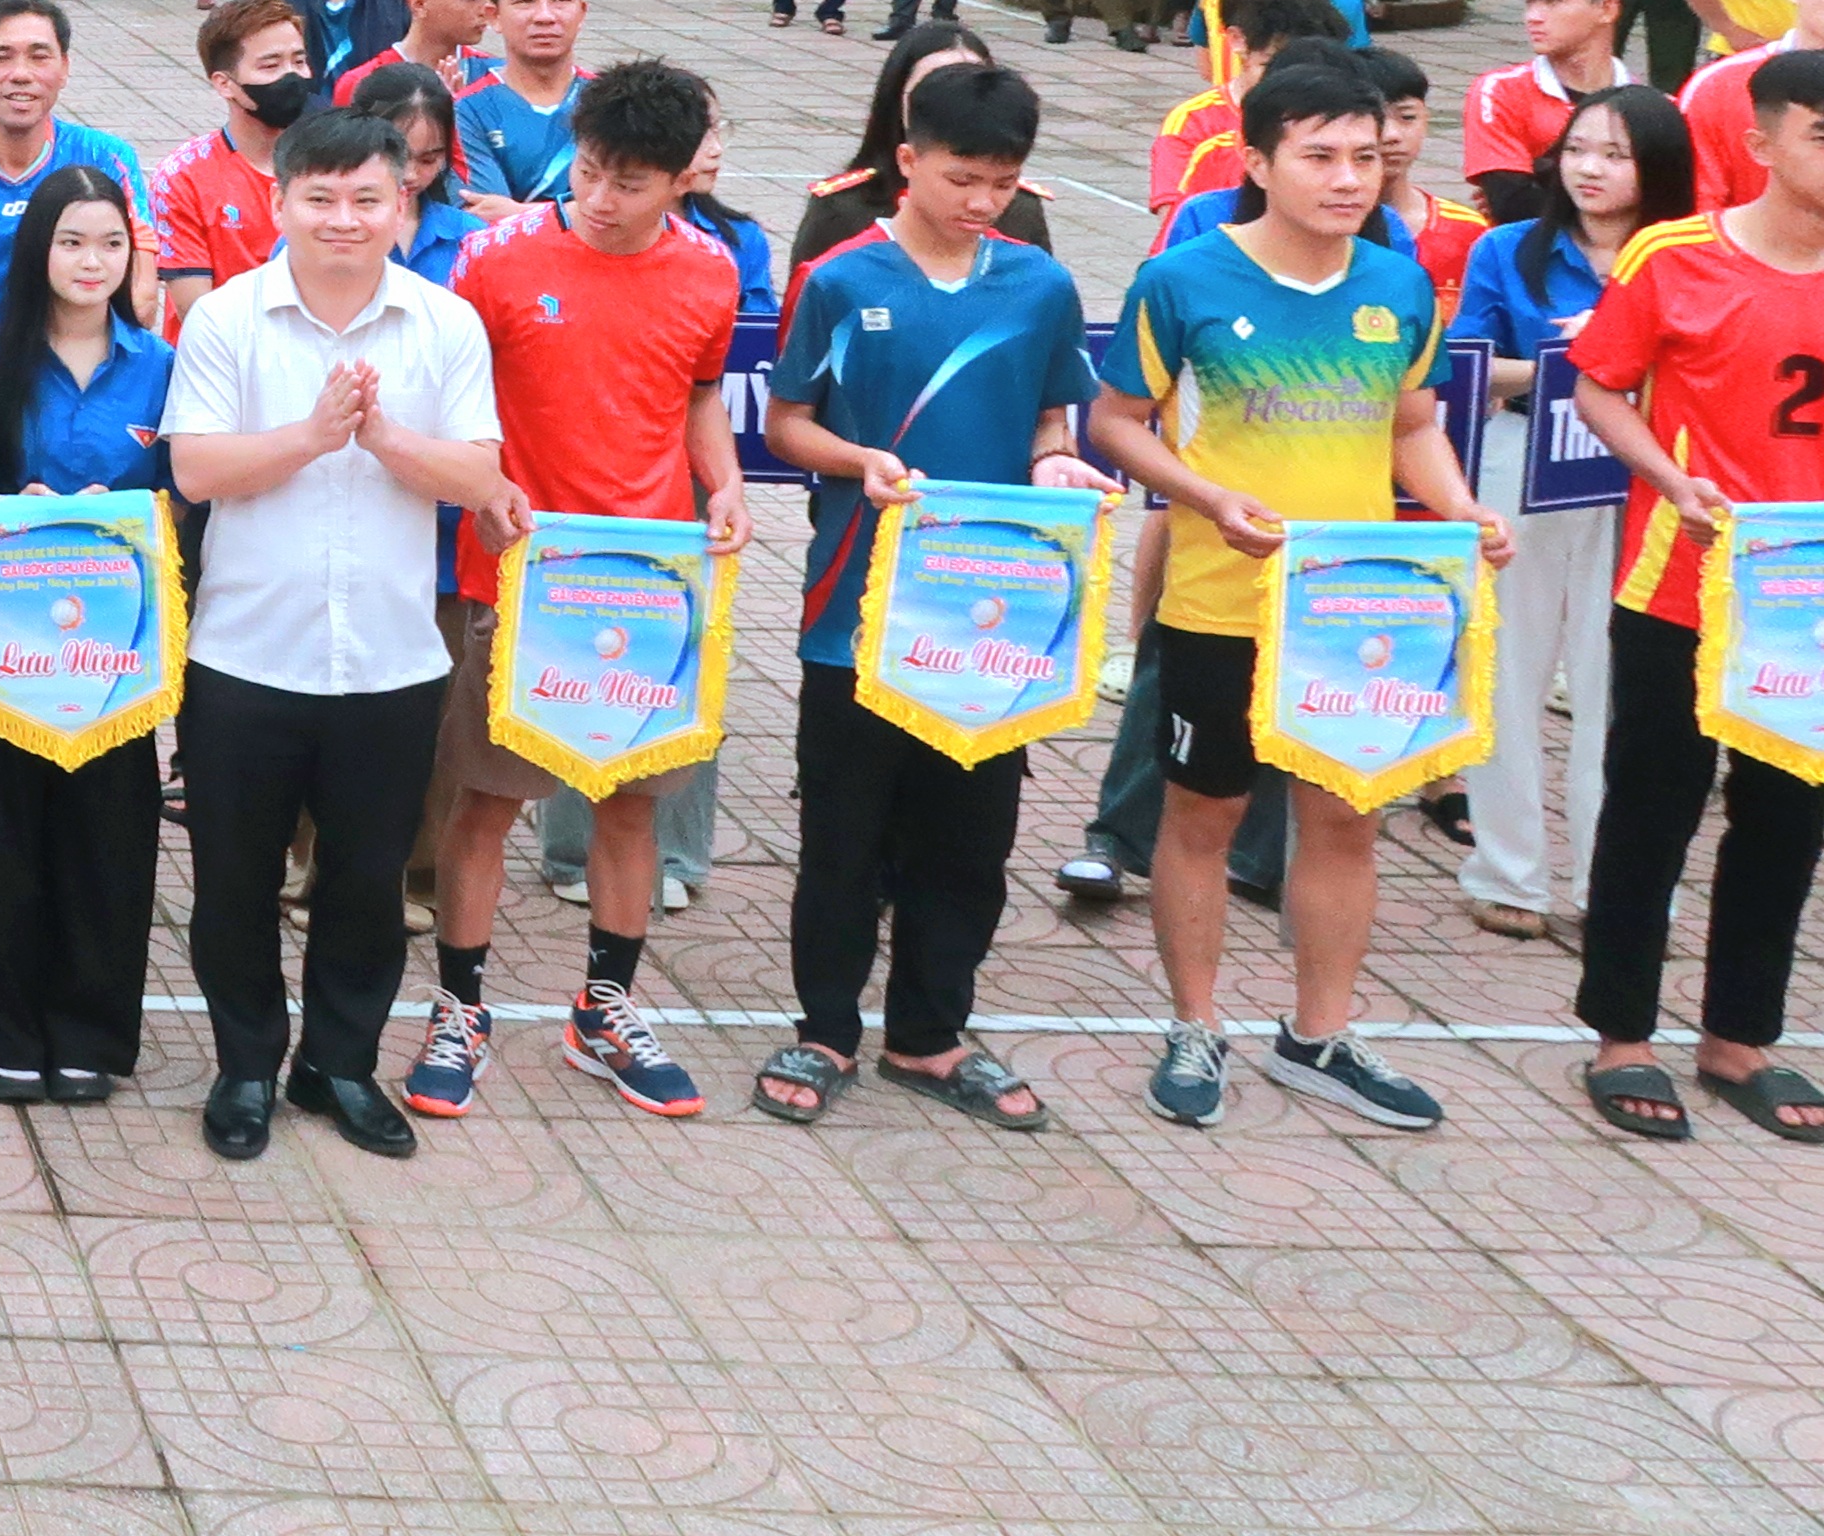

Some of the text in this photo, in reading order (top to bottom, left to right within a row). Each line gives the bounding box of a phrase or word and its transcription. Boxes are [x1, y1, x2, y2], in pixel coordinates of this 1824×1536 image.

[61, 639, 143, 683] Niệm
[900, 634, 1056, 689] Lưu Niệm
[529, 666, 679, 715] Lưu Niệm
